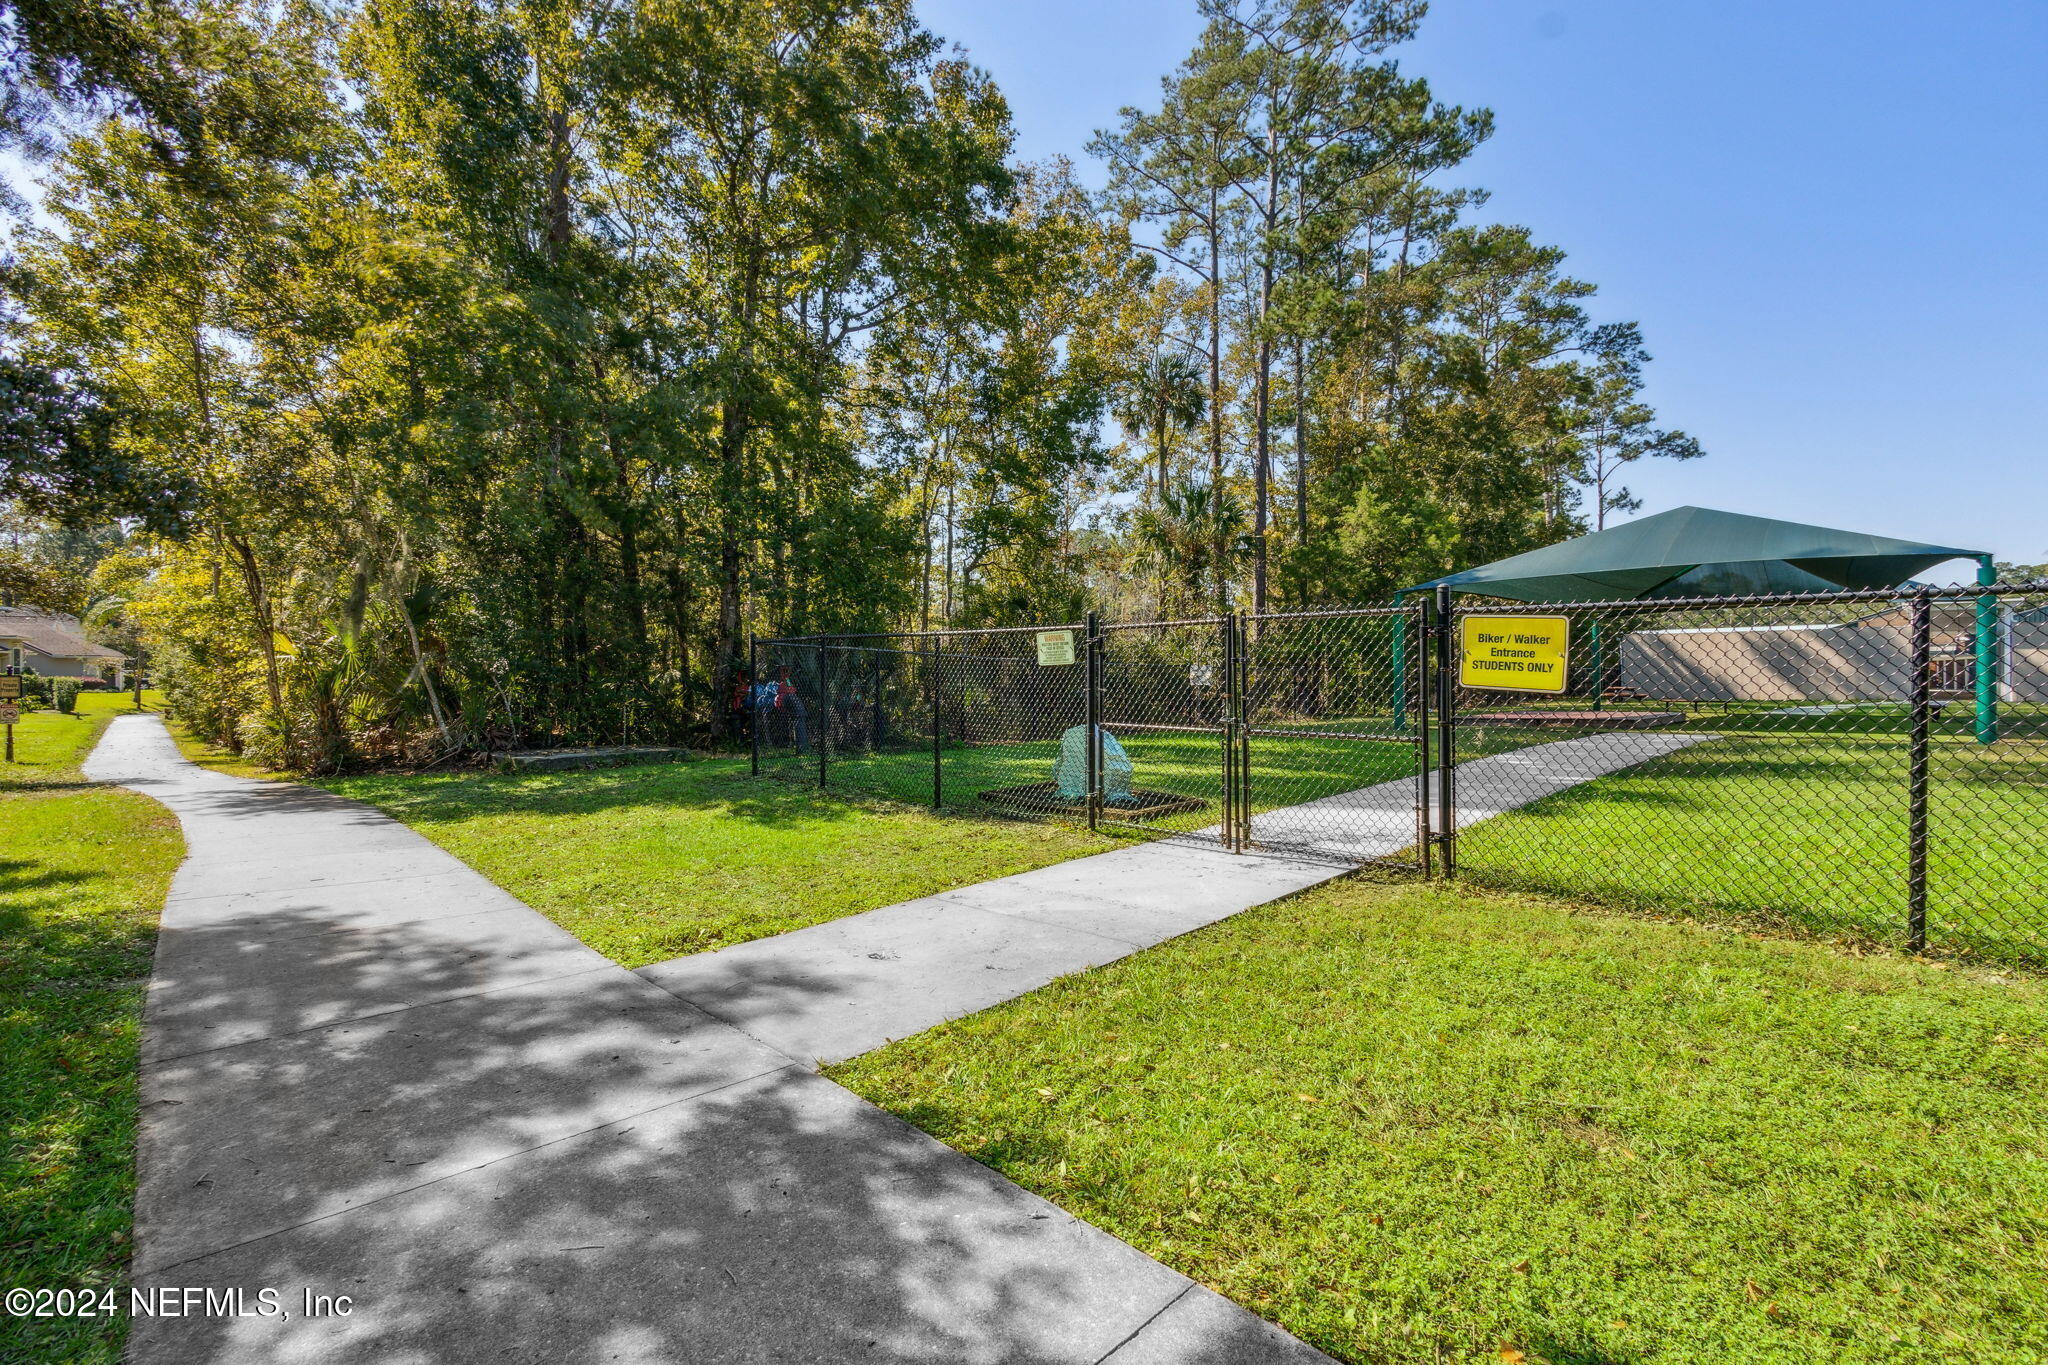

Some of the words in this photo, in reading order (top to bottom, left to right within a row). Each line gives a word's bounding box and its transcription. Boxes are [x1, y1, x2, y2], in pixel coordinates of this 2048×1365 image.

[1478, 633, 1504, 643] Biker
[1506, 634, 1512, 644] /
[1514, 634, 1551, 645] Walker
[1490, 647, 1536, 658] Entrance
[1472, 660, 1524, 672] STUDENTS
[1527, 662, 1554, 673] ONLY
